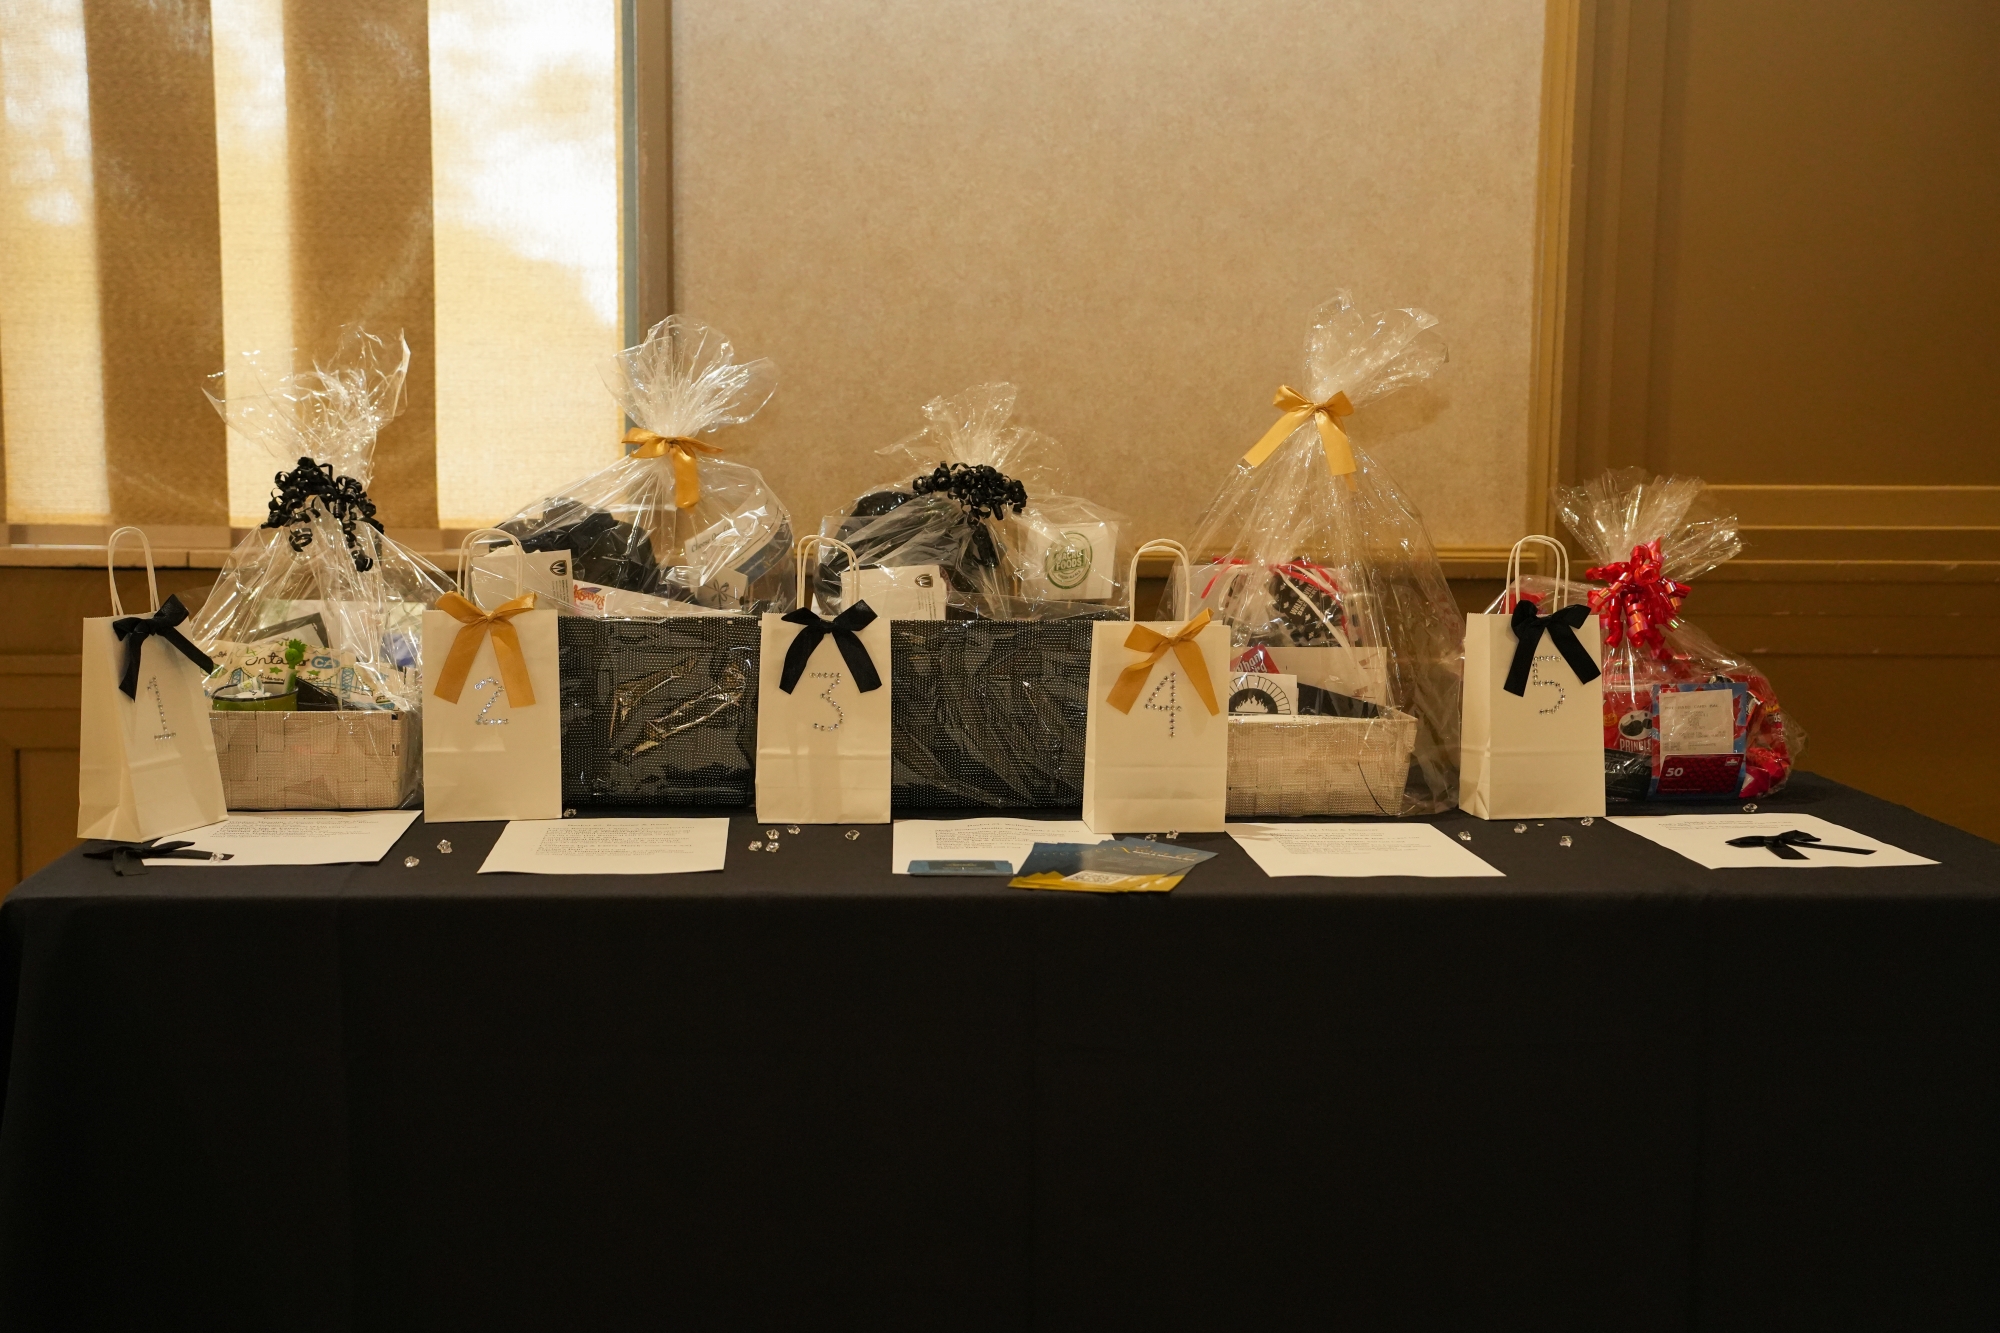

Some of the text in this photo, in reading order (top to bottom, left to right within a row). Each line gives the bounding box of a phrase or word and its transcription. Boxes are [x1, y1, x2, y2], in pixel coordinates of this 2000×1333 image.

[1055, 557, 1082, 571] FOODS
[245, 652, 310, 667] Ontao
[146, 675, 177, 741] 1
[474, 676, 510, 726] 2
[809, 672, 845, 732] 3
[1143, 670, 1183, 739] 4
[1531, 655, 1567, 716] 5
[1619, 737, 1651, 751] PRINGLE
[1665, 767, 1684, 777] 50
